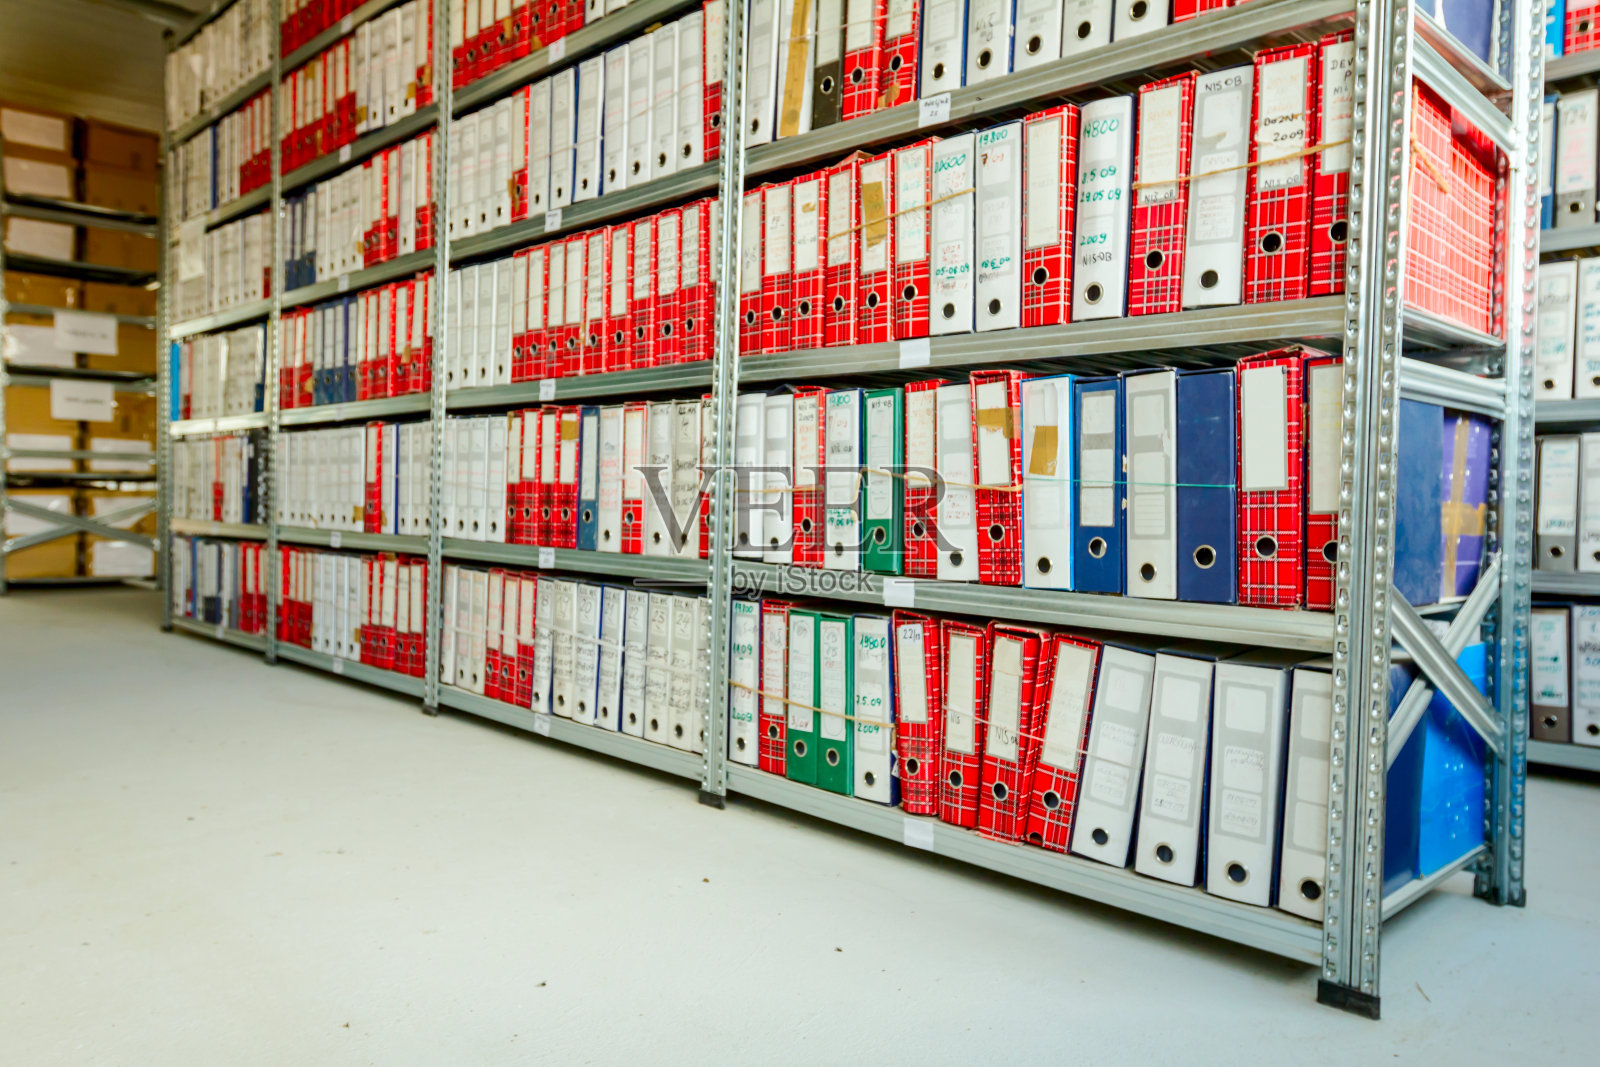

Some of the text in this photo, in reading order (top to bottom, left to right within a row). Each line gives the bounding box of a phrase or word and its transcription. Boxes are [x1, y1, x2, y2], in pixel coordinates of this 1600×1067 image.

[1272, 128, 1304, 141] 2009
[1080, 231, 1107, 246] 2009
[858, 635, 888, 651] 19800
